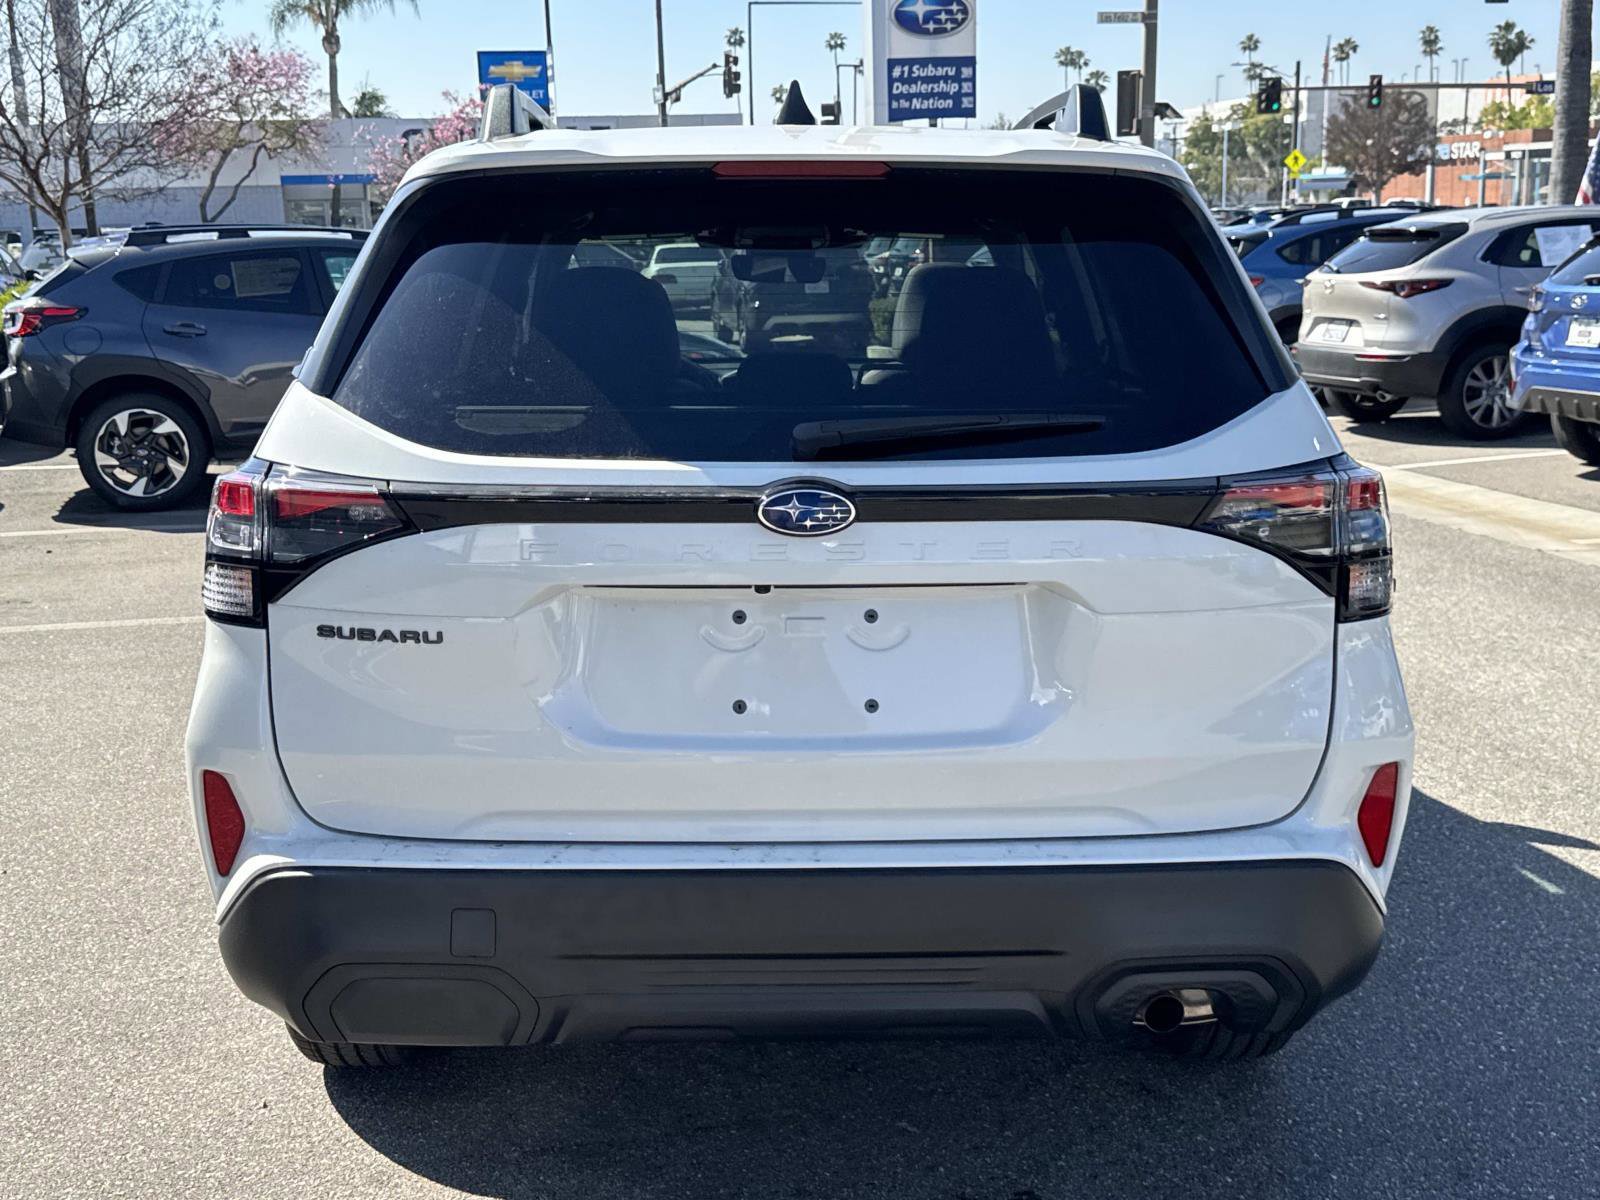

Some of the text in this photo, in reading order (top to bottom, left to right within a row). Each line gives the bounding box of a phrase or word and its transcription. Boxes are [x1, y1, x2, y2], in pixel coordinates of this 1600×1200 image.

[892, 65, 909, 78] #1
[911, 63, 956, 77] Subaru
[892, 80, 959, 95] Dealership
[911, 97, 953, 109] Nation
[1451, 141, 1480, 159] STAR
[519, 538, 1083, 561] FORESTER
[316, 624, 443, 644] SUBARU
